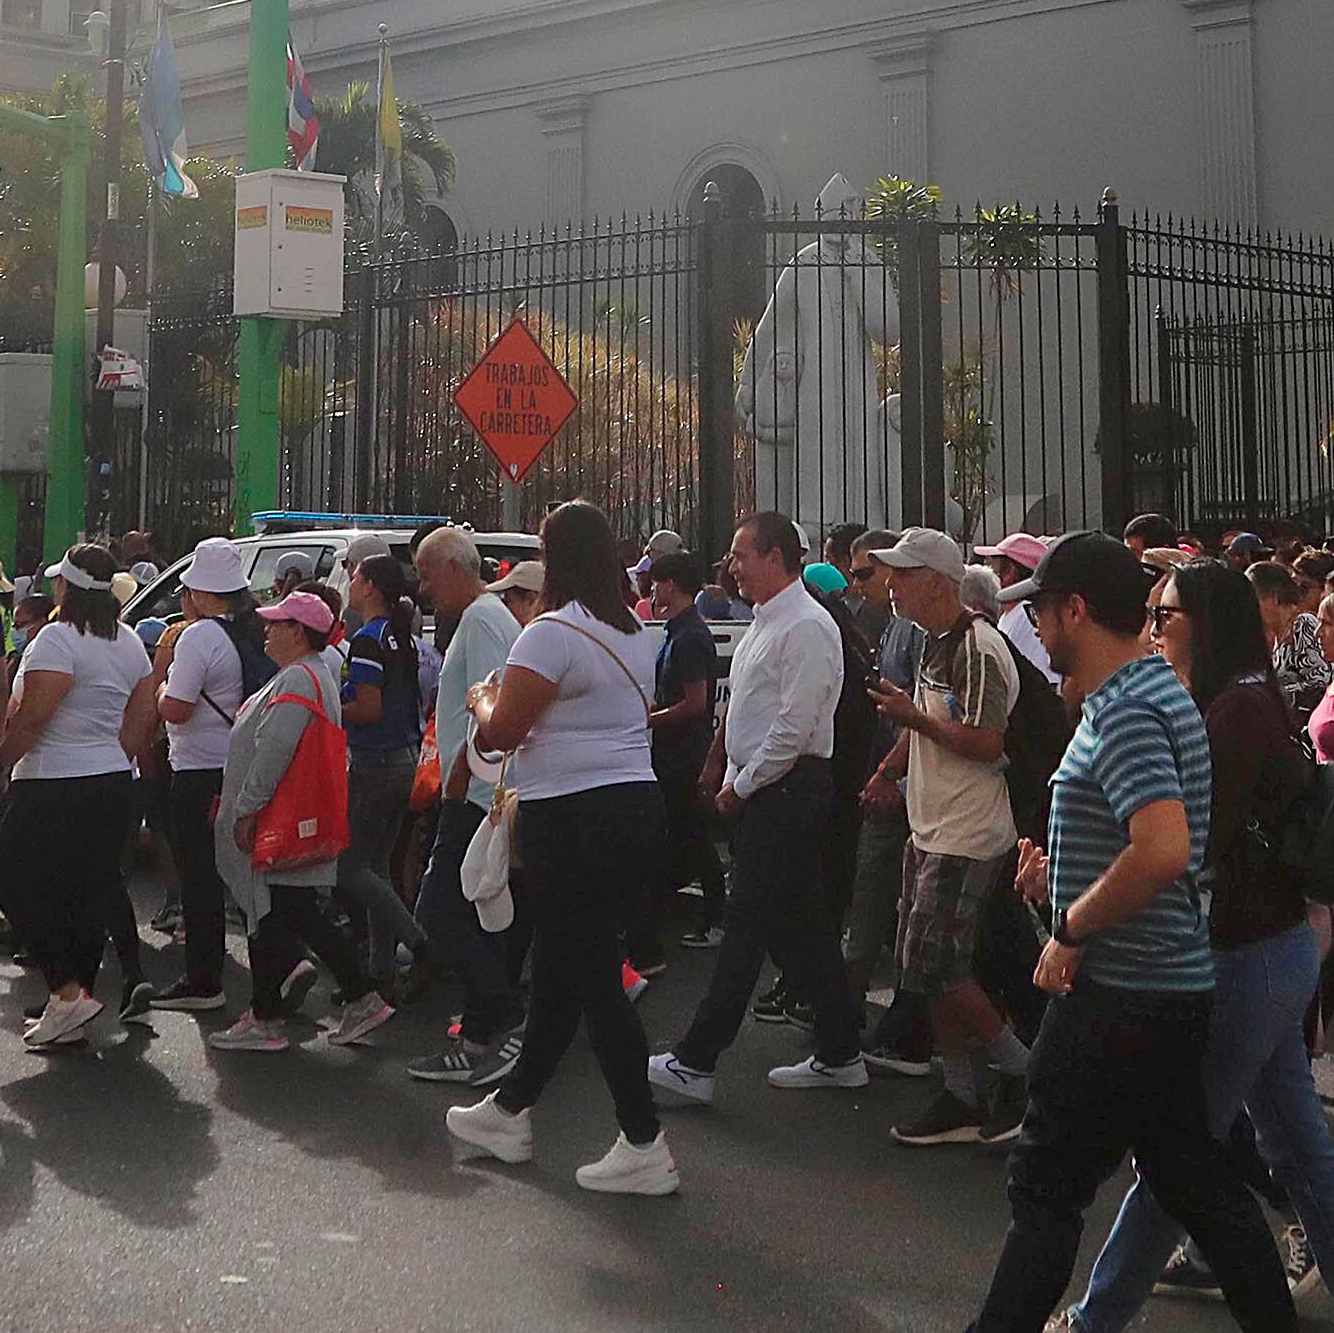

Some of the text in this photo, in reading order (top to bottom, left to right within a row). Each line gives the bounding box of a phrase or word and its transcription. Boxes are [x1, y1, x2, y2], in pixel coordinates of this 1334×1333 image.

[285, 212, 332, 228] heliotek
[485, 363, 550, 387] TRABAJOS
[496, 388, 537, 410] EN LA
[480, 411, 552, 435] CARRETERA
